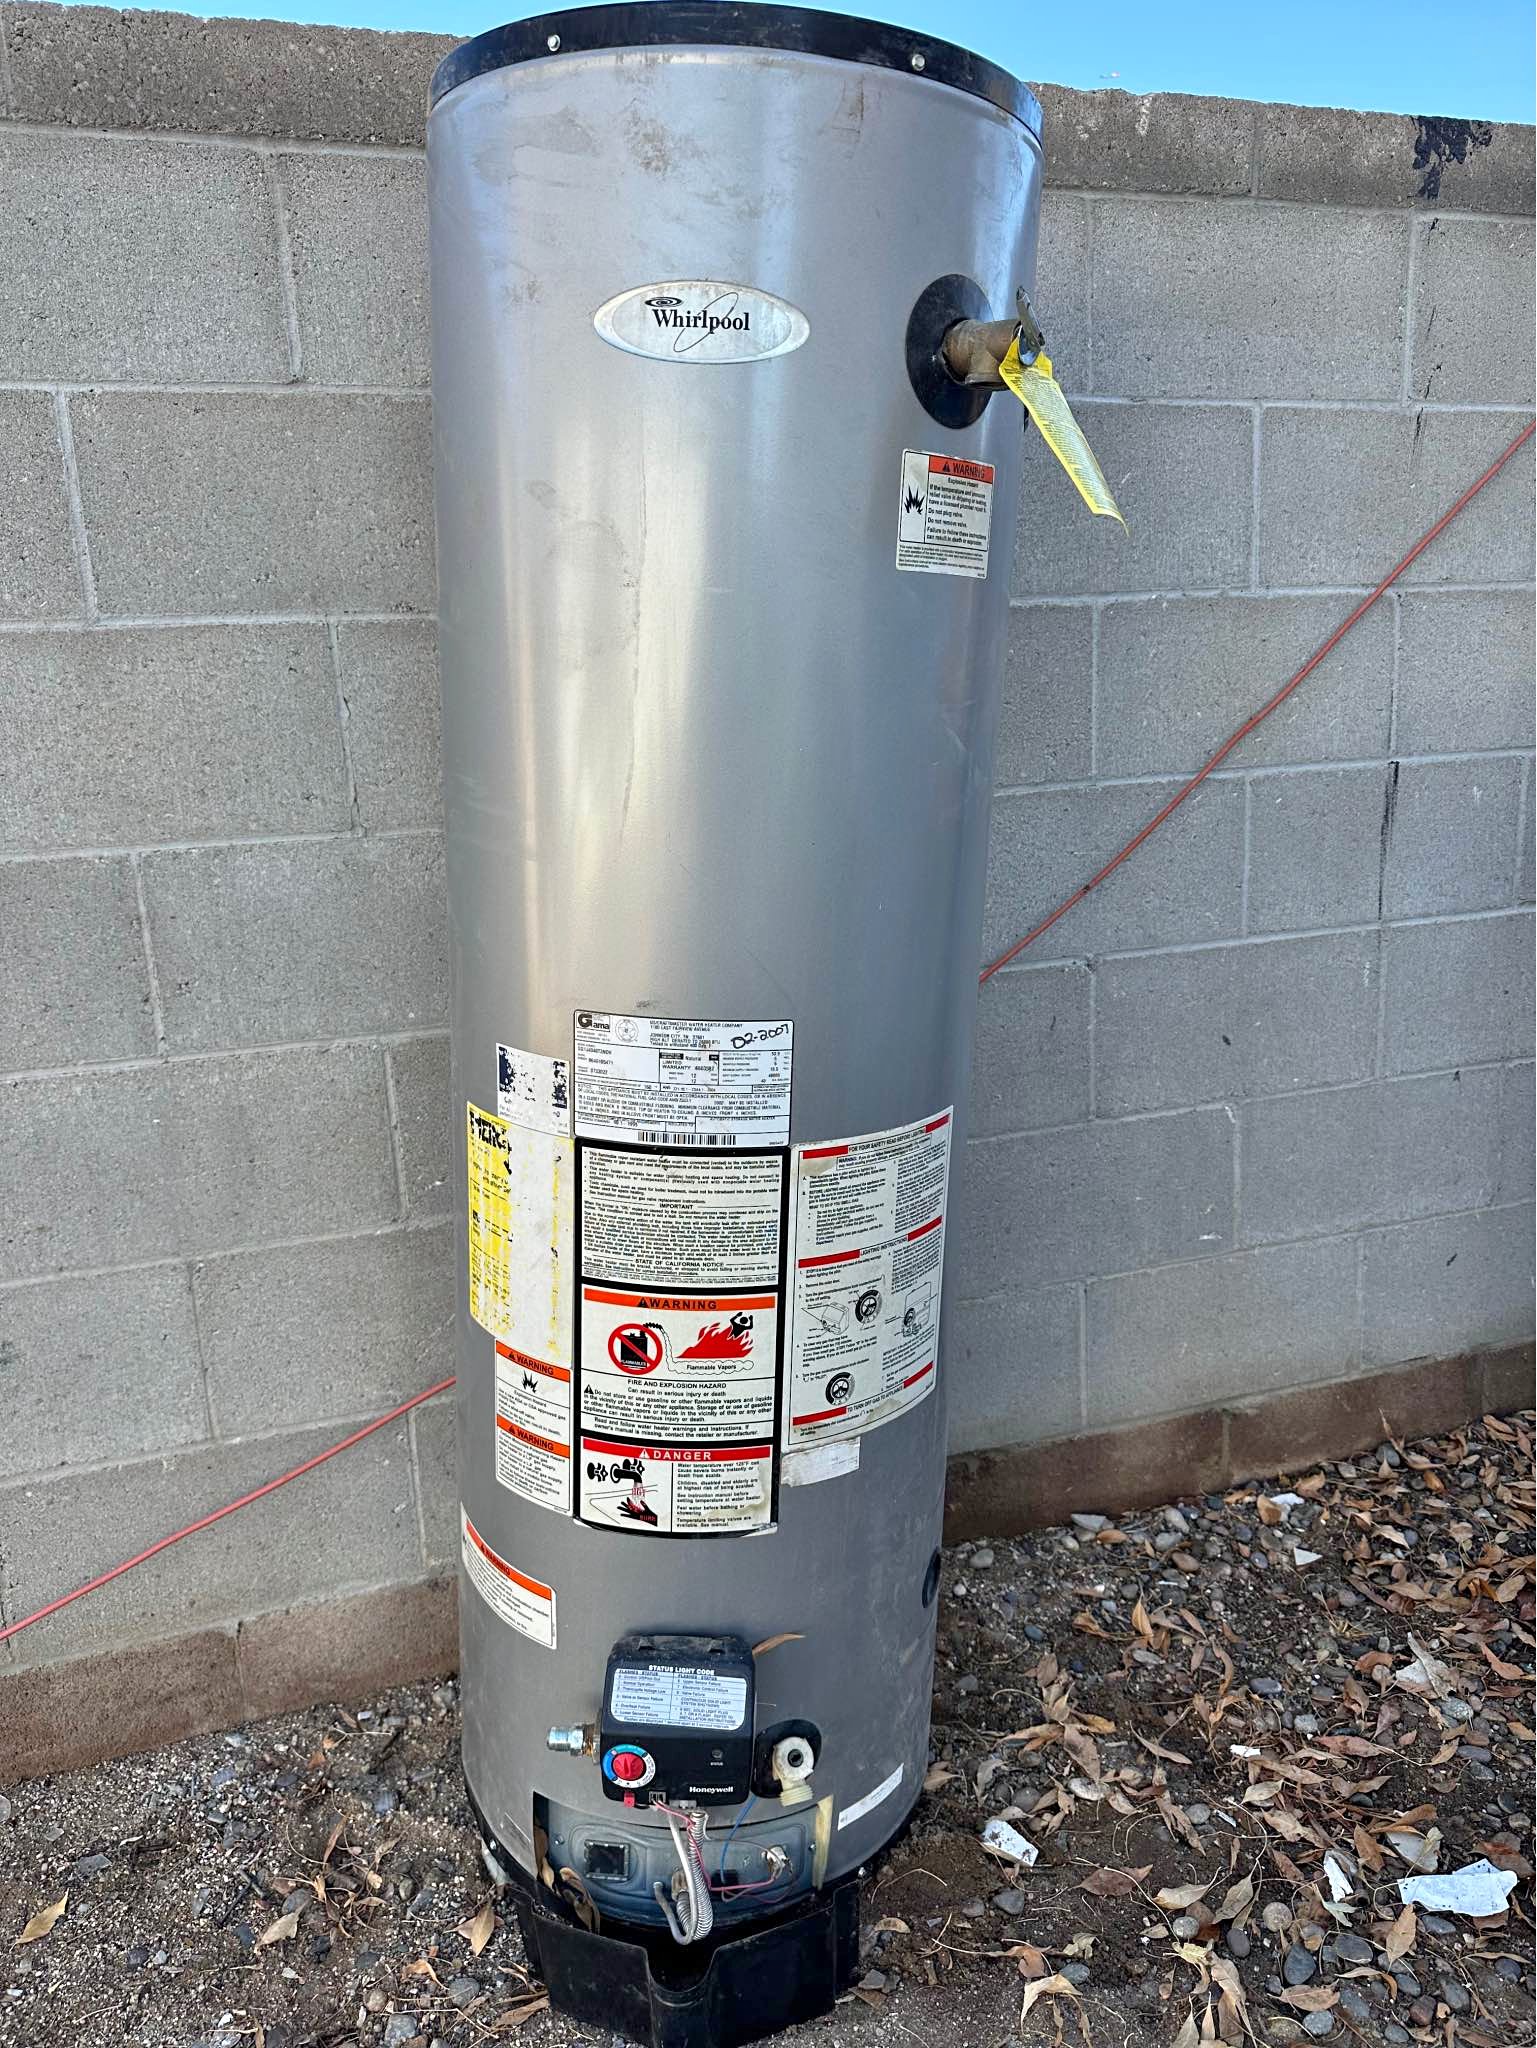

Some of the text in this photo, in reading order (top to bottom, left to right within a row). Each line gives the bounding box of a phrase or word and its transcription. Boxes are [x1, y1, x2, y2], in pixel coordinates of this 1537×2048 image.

[652, 309, 750, 333] Whirlpool
[953, 462, 985, 479] WARNING
[649, 1299, 717, 1310] WARNING
[516, 1354, 555, 1376] WARNING
[584, 1405, 607, 1414] appliance
[605, 1403, 631, 1412] flammable
[517, 1429, 555, 1451] WARNING
[654, 1451, 712, 1460] DANGER
[485, 1547, 511, 1576] WARNING
[648, 1665, 715, 1676] STATUS LIGHT CODE
[689, 1786, 734, 1794] Honeywell
